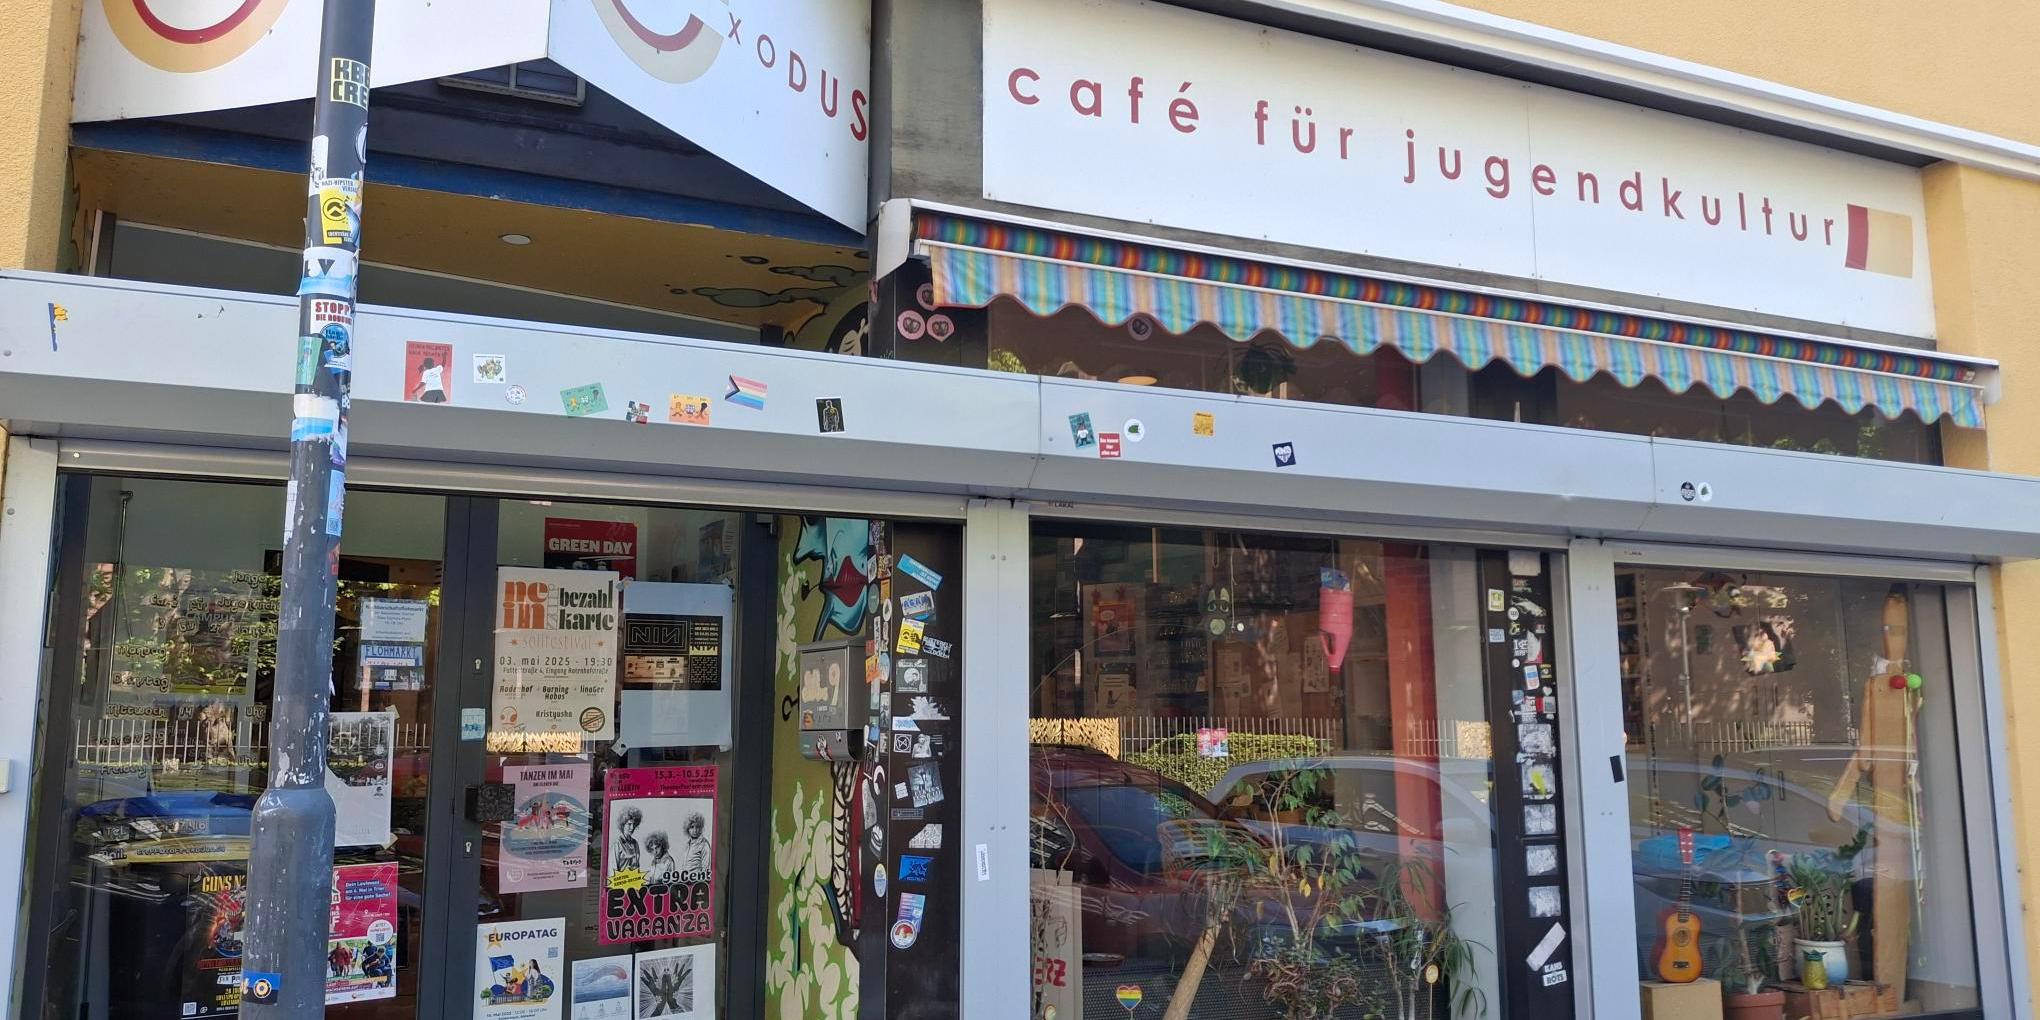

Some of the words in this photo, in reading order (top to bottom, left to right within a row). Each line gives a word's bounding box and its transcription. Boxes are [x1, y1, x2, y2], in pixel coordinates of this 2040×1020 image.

[1008, 68, 1199, 133] café
[1255, 101, 1353, 159] für
[1404, 129, 1834, 246] jugendkultur
[548, 537, 600, 553] GREEN
[603, 540, 633, 554] DAY
[560, 580, 613, 608] bezahl
[559, 609, 614, 631] karte
[545, 656, 570, 666] 2025
[585, 657, 613, 667] 19:30
[520, 771, 546, 781] TANZEN
[548, 770, 557, 780] IM
[559, 769, 574, 779] MAI
[607, 882, 711, 918] EXTRA
[488, 928, 558, 943] EUROPATAG
